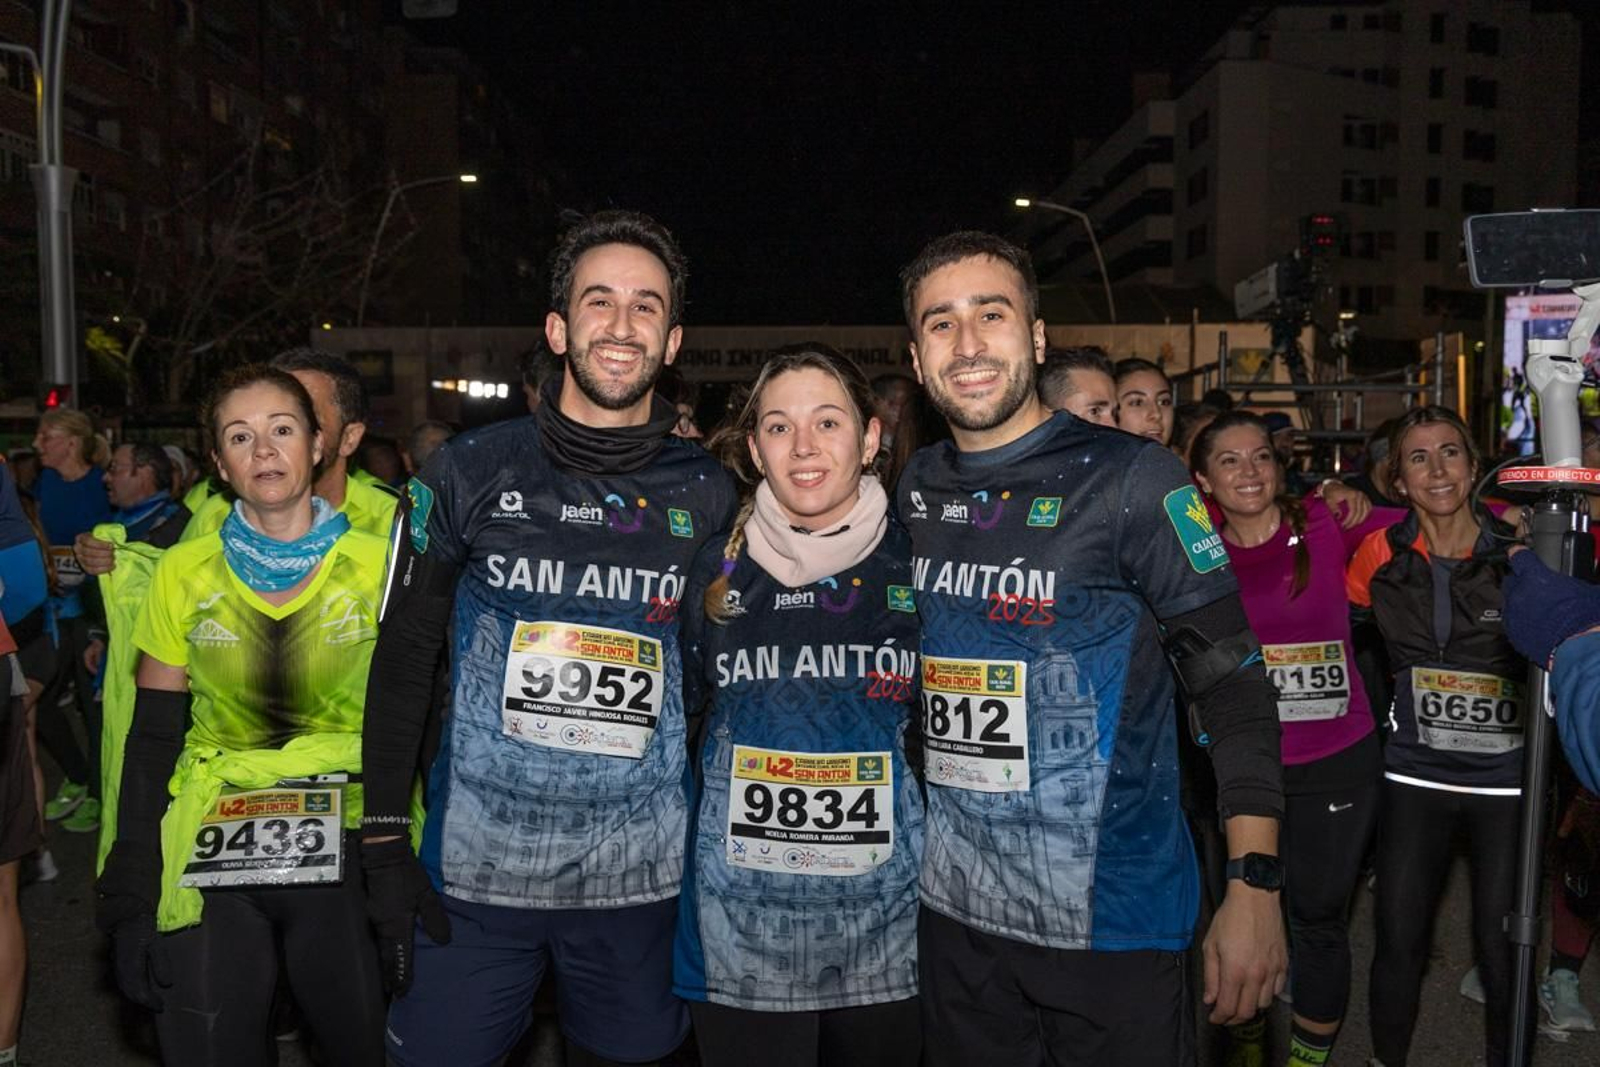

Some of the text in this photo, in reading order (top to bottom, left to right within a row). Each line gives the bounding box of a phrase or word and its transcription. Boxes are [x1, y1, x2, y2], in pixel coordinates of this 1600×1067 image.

[1531, 470, 1544, 479] EN
[1547, 470, 1592, 480] DIRECTO
[487, 554, 565, 594] SAN
[932, 557, 1056, 607] ANTÓN
[646, 597, 681, 623] 20
[988, 593, 1056, 626] 2025
[716, 638, 916, 688] SAN ANTÓN
[521, 657, 653, 712] 9952
[523, 702, 561, 713] FRANCISCO
[563, 707, 587, 717] JAVIER
[589, 711, 621, 721] HINOJOSA
[1421, 692, 1518, 724] 6650
[766, 757, 794, 778] 42
[794, 769, 815, 779] SAN
[220, 799, 246, 817] 42
[744, 783, 880, 830] 9834
[195, 818, 326, 860] 9436
[765, 830, 854, 842] NOELIA ROMERA MIRANDA
